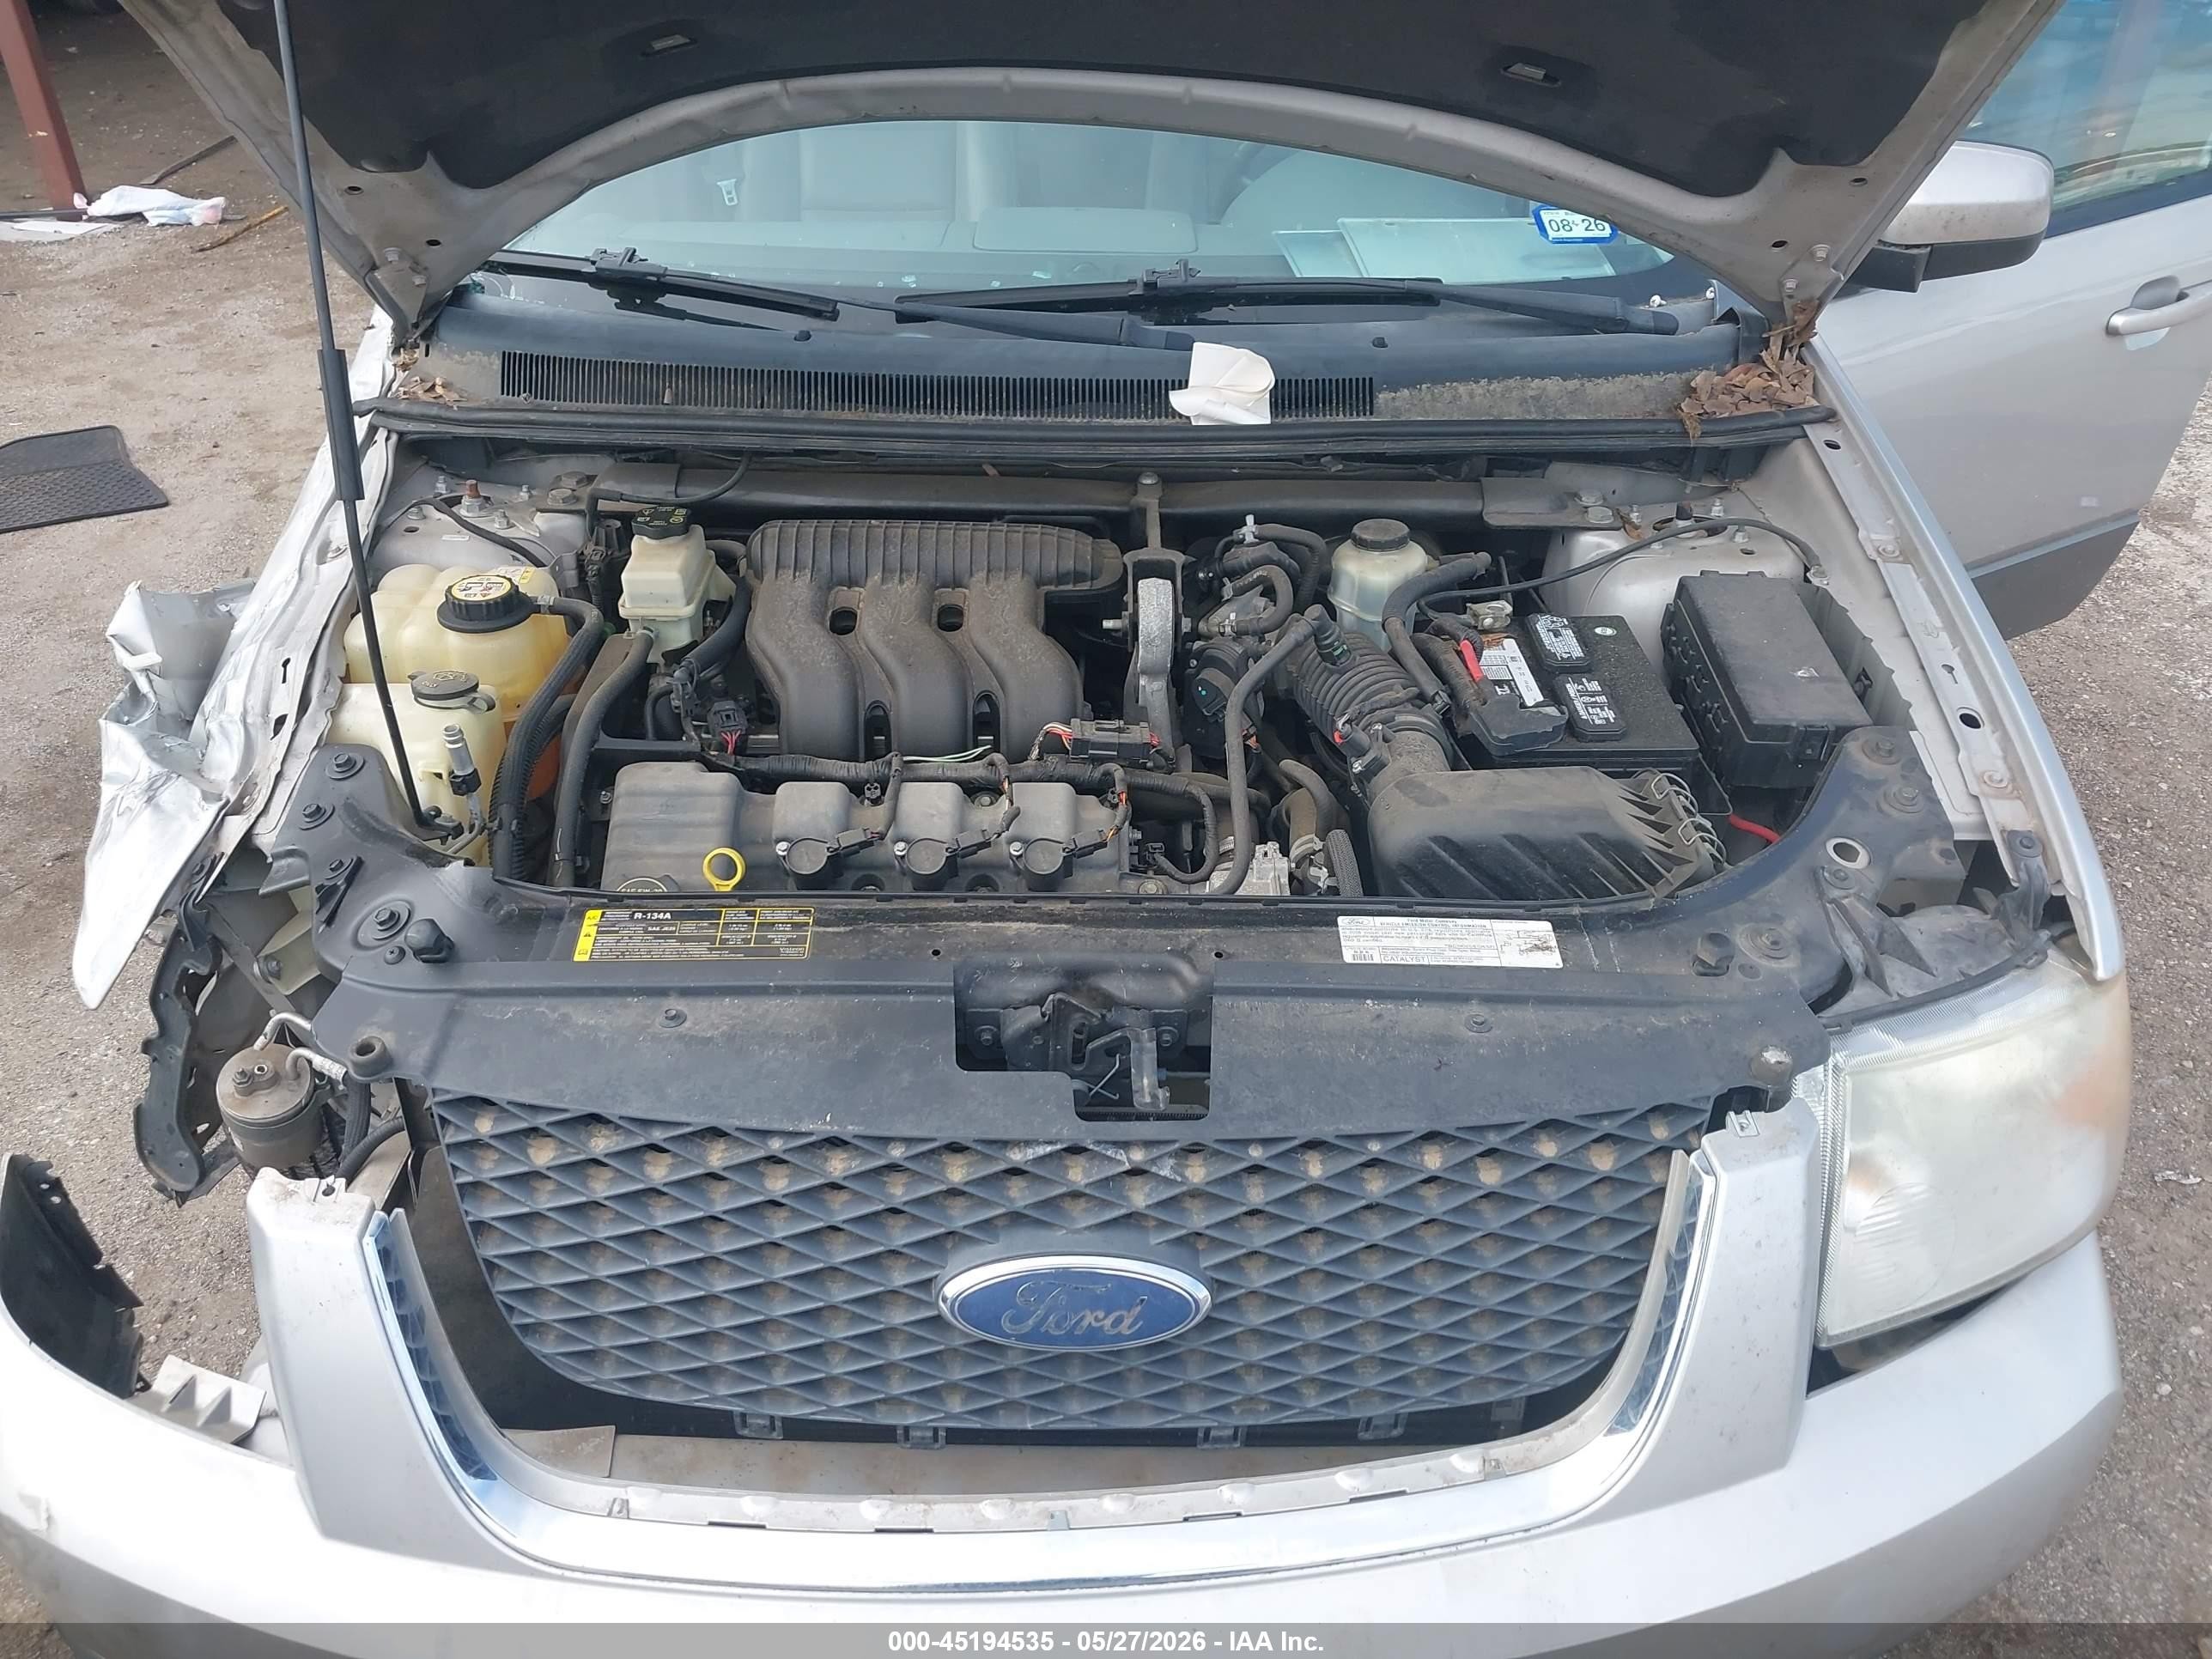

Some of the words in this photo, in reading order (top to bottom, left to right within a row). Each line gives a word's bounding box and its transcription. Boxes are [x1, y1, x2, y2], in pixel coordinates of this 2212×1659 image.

[1548, 218, 1573, 233] 08
[1581, 218, 1606, 232] 26
[1000, 1279, 1148, 1335] Ford
